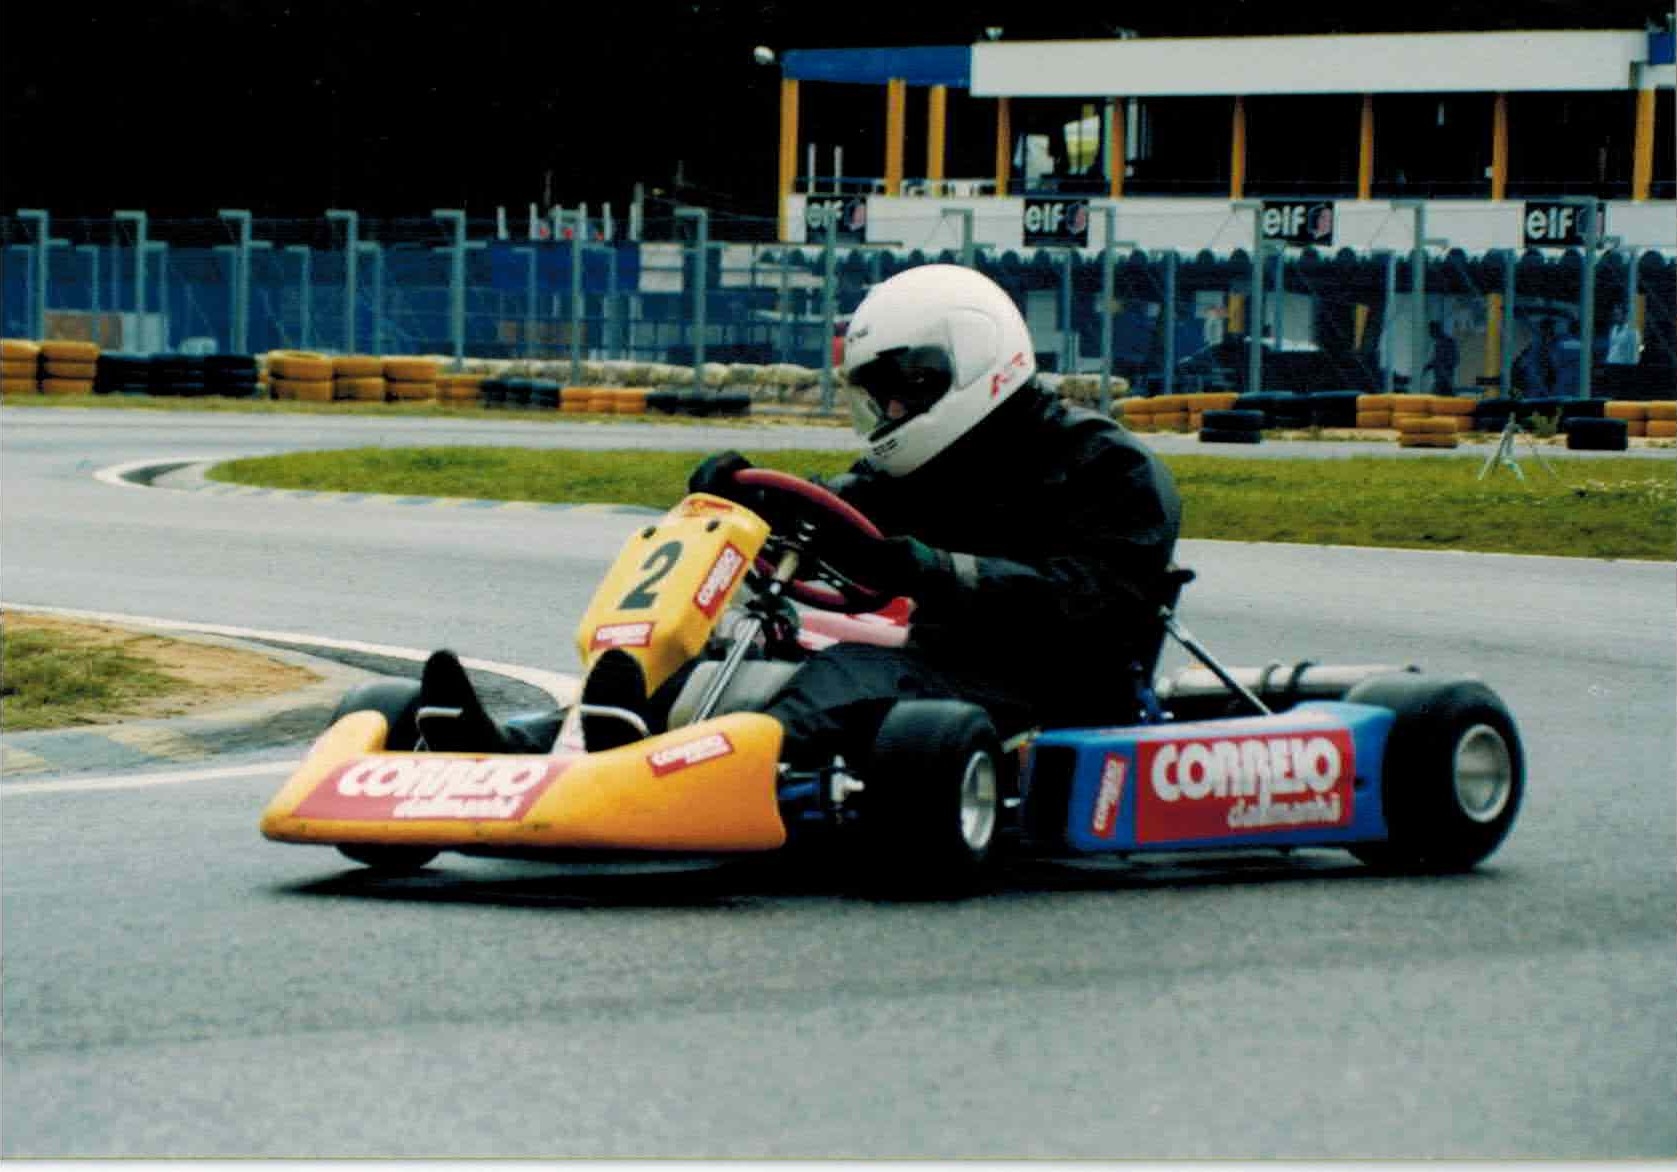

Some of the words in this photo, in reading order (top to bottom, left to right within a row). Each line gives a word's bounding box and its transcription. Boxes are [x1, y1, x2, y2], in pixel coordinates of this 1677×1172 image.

[1025, 204, 1063, 231] elf
[1263, 206, 1305, 236] elf
[1527, 207, 1573, 239] elf
[617, 540, 683, 610] 2
[1152, 738, 1341, 812] CORREIO
